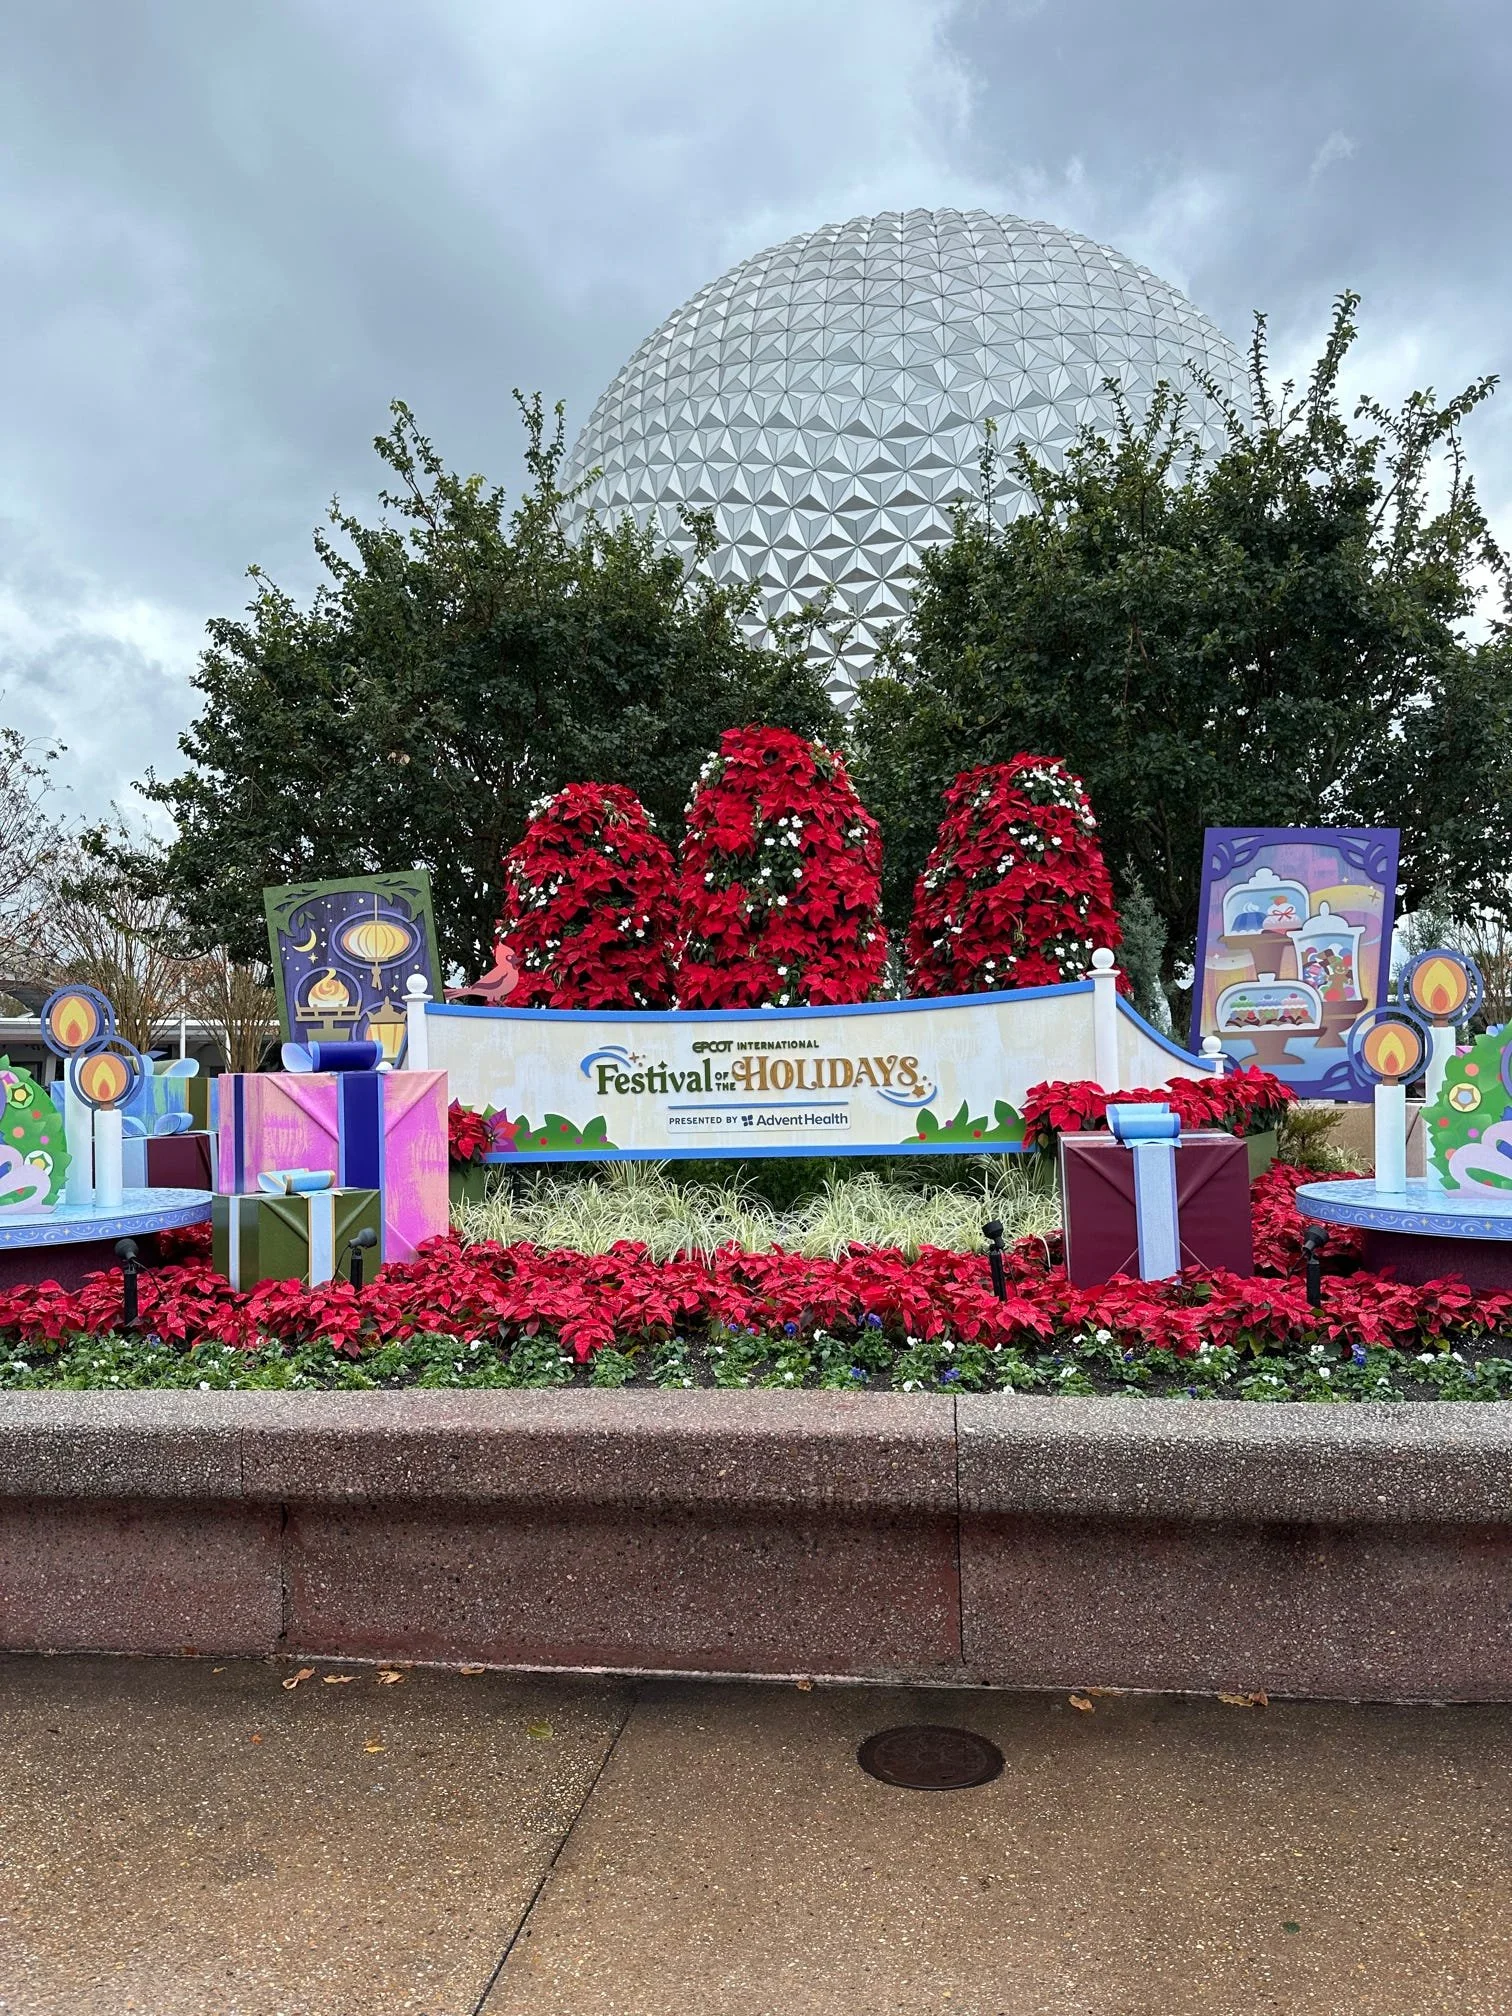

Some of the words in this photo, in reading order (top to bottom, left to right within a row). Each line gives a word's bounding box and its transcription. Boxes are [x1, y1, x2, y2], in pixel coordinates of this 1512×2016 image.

[692, 1040, 733, 1053] EPCOT
[737, 1039, 819, 1051] INTERNATIONAL
[596, 1058, 713, 1095] Festival
[715, 1072, 729, 1081] OF
[731, 1055, 918, 1092] HOLIDAYS
[715, 1081, 736, 1092] THE
[668, 1116, 722, 1126] PRESENTED
[725, 1116, 738, 1125] BY
[756, 1113, 848, 1127] AdventHealth
